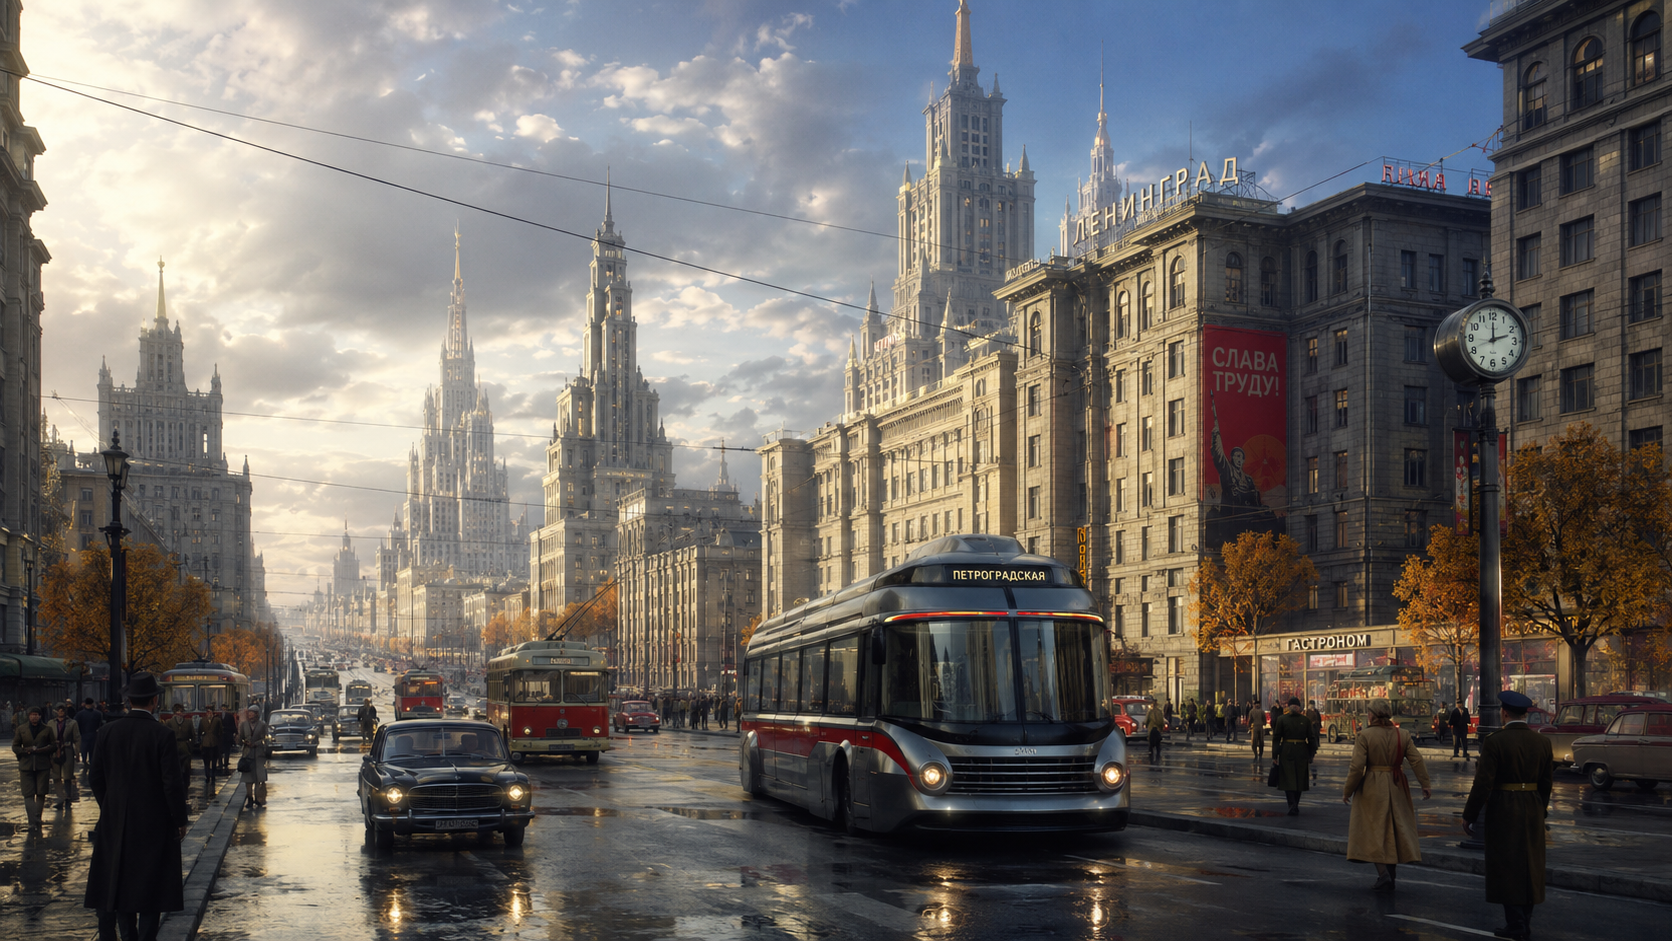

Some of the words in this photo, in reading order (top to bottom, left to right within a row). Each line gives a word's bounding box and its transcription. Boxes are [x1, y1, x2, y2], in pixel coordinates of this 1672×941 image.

[1073, 156, 1239, 248] ЛЕНИНГРАД
[1479, 315, 1485, 323] 11
[1489, 312, 1497, 321] 12
[1502, 316, 1505, 324] 1
[1471, 323, 1479, 331] 10
[1468, 334, 1474, 342] 9
[1512, 337, 1517, 345] 3
[1471, 346, 1476, 354] 8
[1212, 346, 1279, 373] СЛАВА
[1480, 356, 1485, 365] 7
[1490, 359, 1496, 367] 6
[1501, 357, 1507, 365] 5
[1212, 370, 1279, 398] ТРУДУ!
[952, 570, 1046, 582] ПЕТРОГРАДСКАЯ
[1286, 634, 1368, 651] ГАСТРОНОМ
